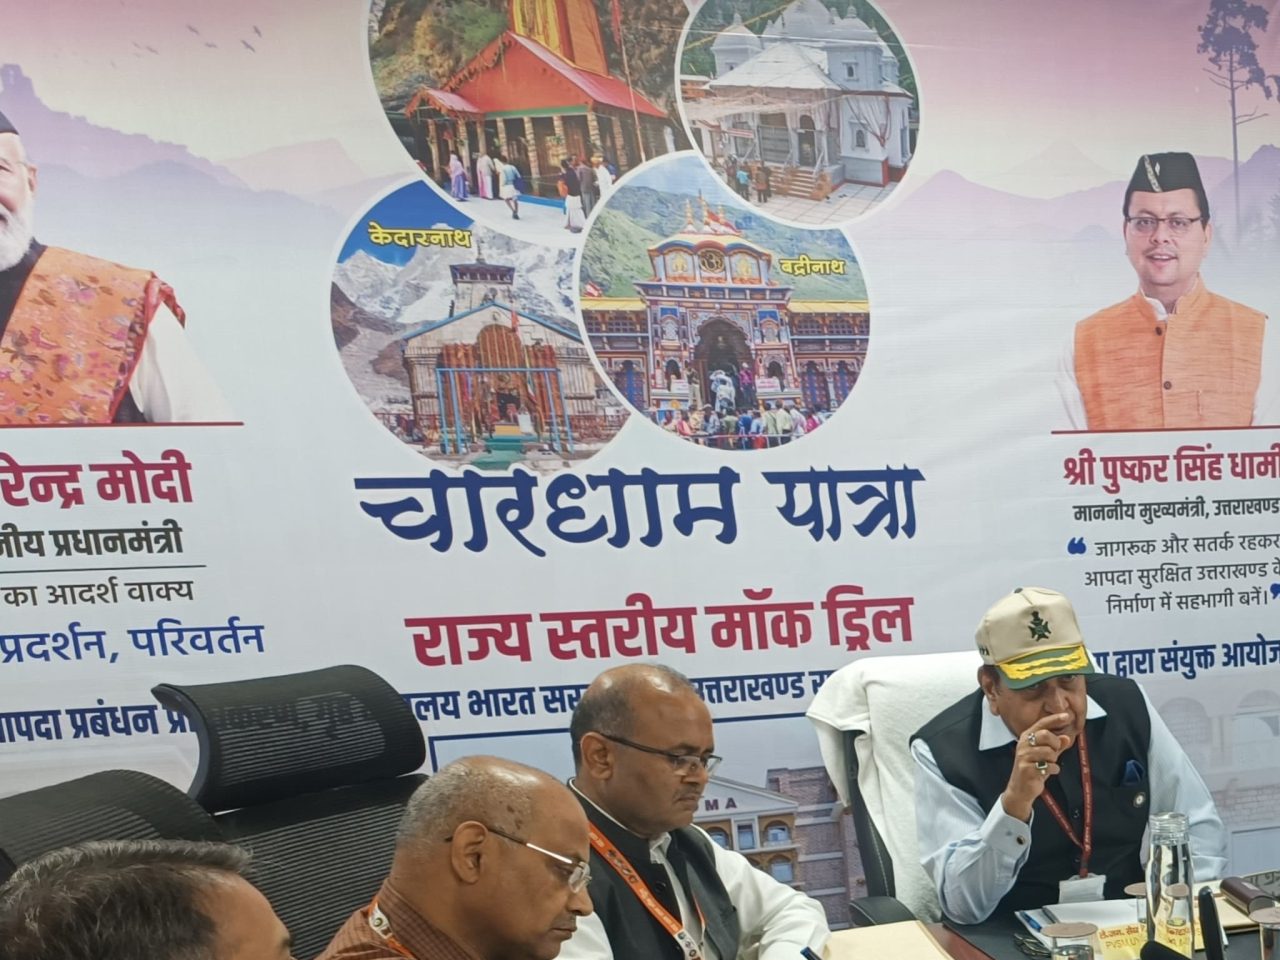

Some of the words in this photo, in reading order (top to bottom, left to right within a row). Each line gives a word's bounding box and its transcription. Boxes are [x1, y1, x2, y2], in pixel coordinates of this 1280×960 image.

[368, 221, 472, 248] केदारनाथ
[779, 253, 846, 276] बद्रीनाथ
[88, 449, 194, 504] मोदी
[1064, 448, 1096, 486] श्री
[1100, 454, 1169, 494] पुष्कर
[1173, 443, 1224, 482] सिंह
[354, 467, 741, 557] चारधाम
[762, 464, 926, 541] यात्रा
[1072, 499, 1136, 523] माननीय
[1138, 496, 1210, 524] मुख्यमंत्री,
[1212, 497, 1280, 516] उत्तराखण्ड
[48, 518, 184, 557] प्रधानमंत्री
[1095, 540, 1157, 558] जागरूक
[1161, 532, 1188, 556] और
[1193, 530, 1234, 553] सतर्क
[1238, 533, 1280, 551] रहकर
[0, 586, 38, 608] का
[46, 576, 118, 605] आदर्श
[124, 581, 194, 602] वाक्य
[1084, 568, 1132, 587] आपदा
[1137, 562, 1193, 589] सुरक्षित
[1197, 561, 1268, 582] उत्तराखण्ड
[1105, 594, 1155, 615] निर्माण
[1159, 589, 1172, 611] में
[1175, 588, 1234, 610] सहभागी
[0, 622, 119, 663] प्रदर्शन,
[127, 616, 265, 657] परिवर्तन
[403, 613, 533, 667] राज्य
[539, 593, 699, 660] स्तरीय
[704, 588, 815, 650] मॉक
[821, 584, 915, 652] ड्रिल
[65, 698, 159, 739] प्रबंधन
[467, 686, 536, 717] भारत
[1113, 649, 1155, 679] द्वारा
[1158, 639, 1216, 680] संयुक्त
